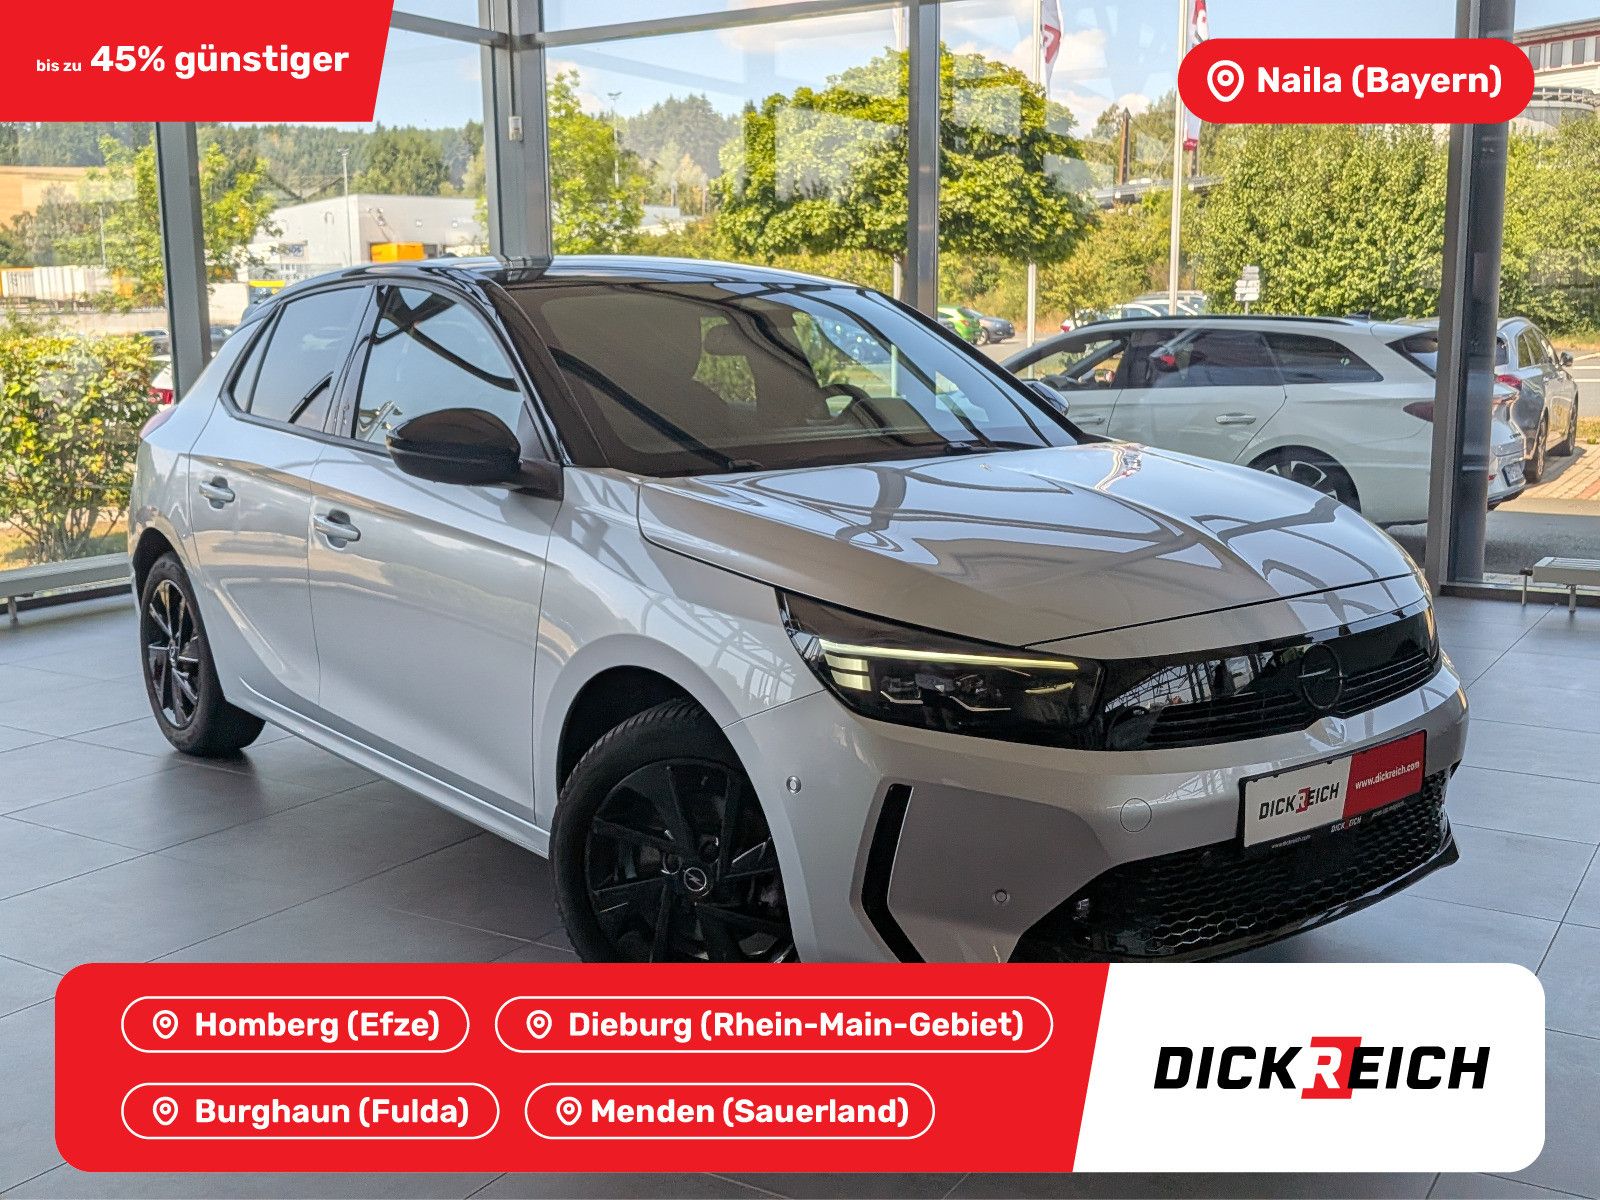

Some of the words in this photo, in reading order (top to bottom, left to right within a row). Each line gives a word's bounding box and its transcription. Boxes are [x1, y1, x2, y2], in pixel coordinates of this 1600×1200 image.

[1354, 760, 1421, 790] www.dickreich.com
[1258, 782, 1340, 820] DICKREICH
[1330, 816, 1362, 834] DICKEICH
